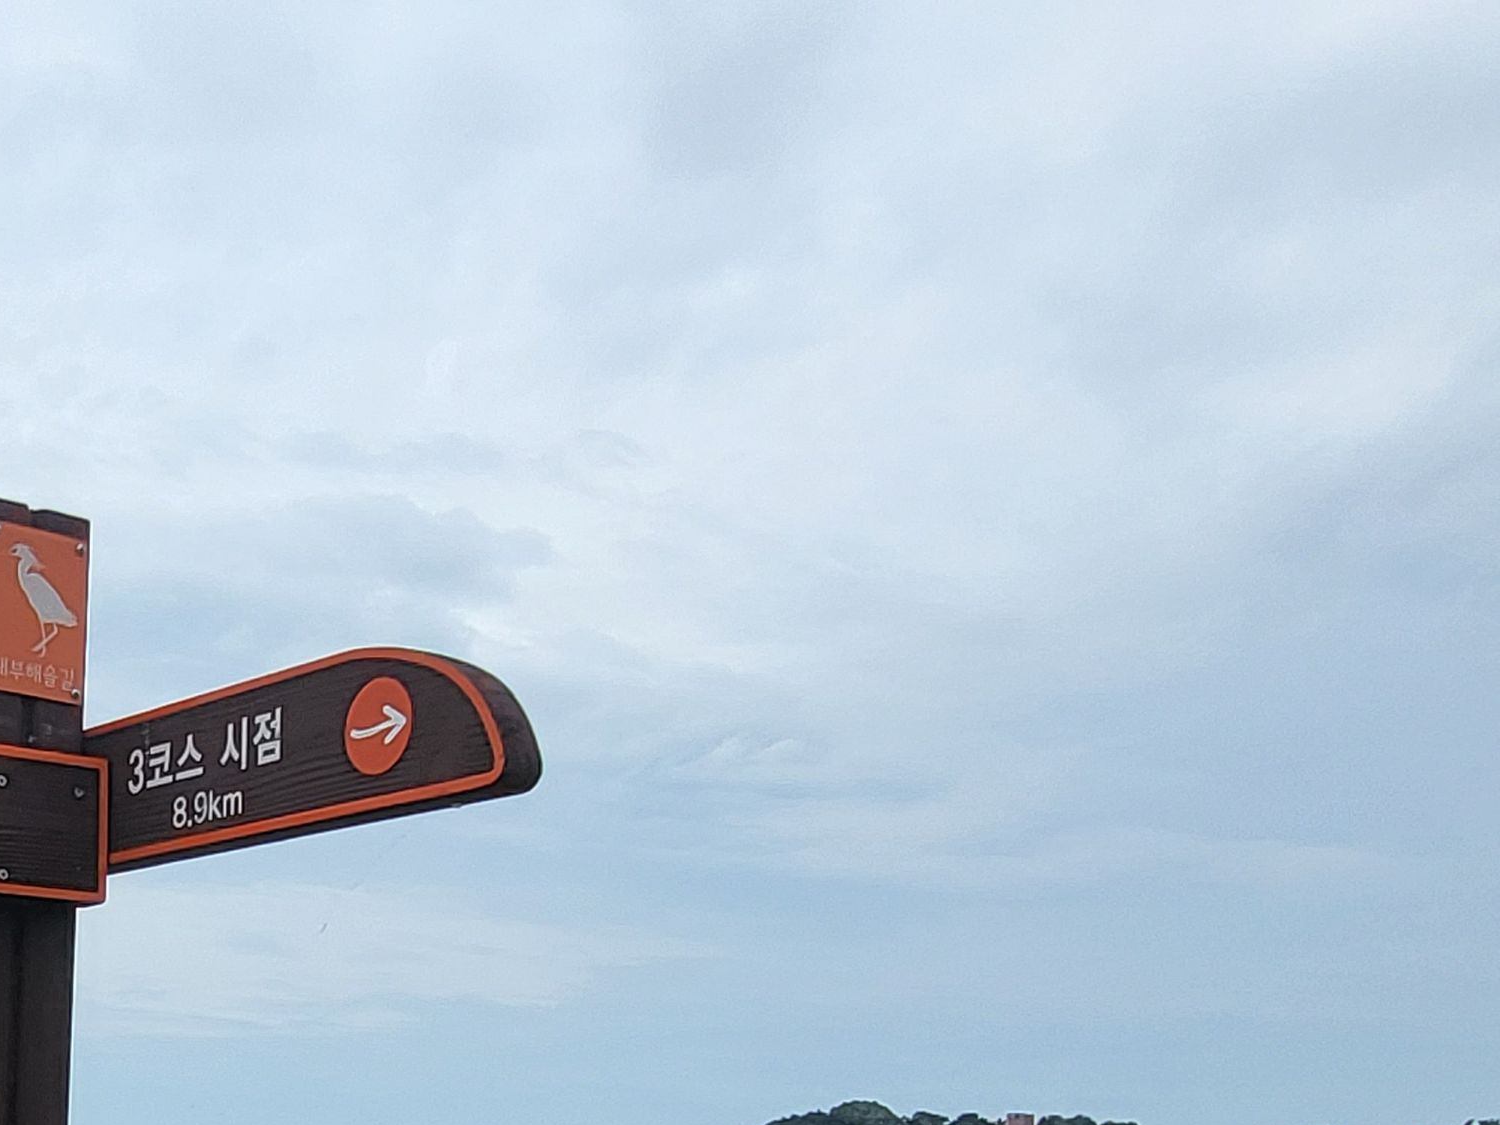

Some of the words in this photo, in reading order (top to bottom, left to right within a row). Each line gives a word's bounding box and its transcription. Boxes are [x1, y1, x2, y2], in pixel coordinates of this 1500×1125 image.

[128, 733, 204, 795] 3코스
[219, 706, 282, 770] 시점
[171, 790, 243, 829] 8.9km
